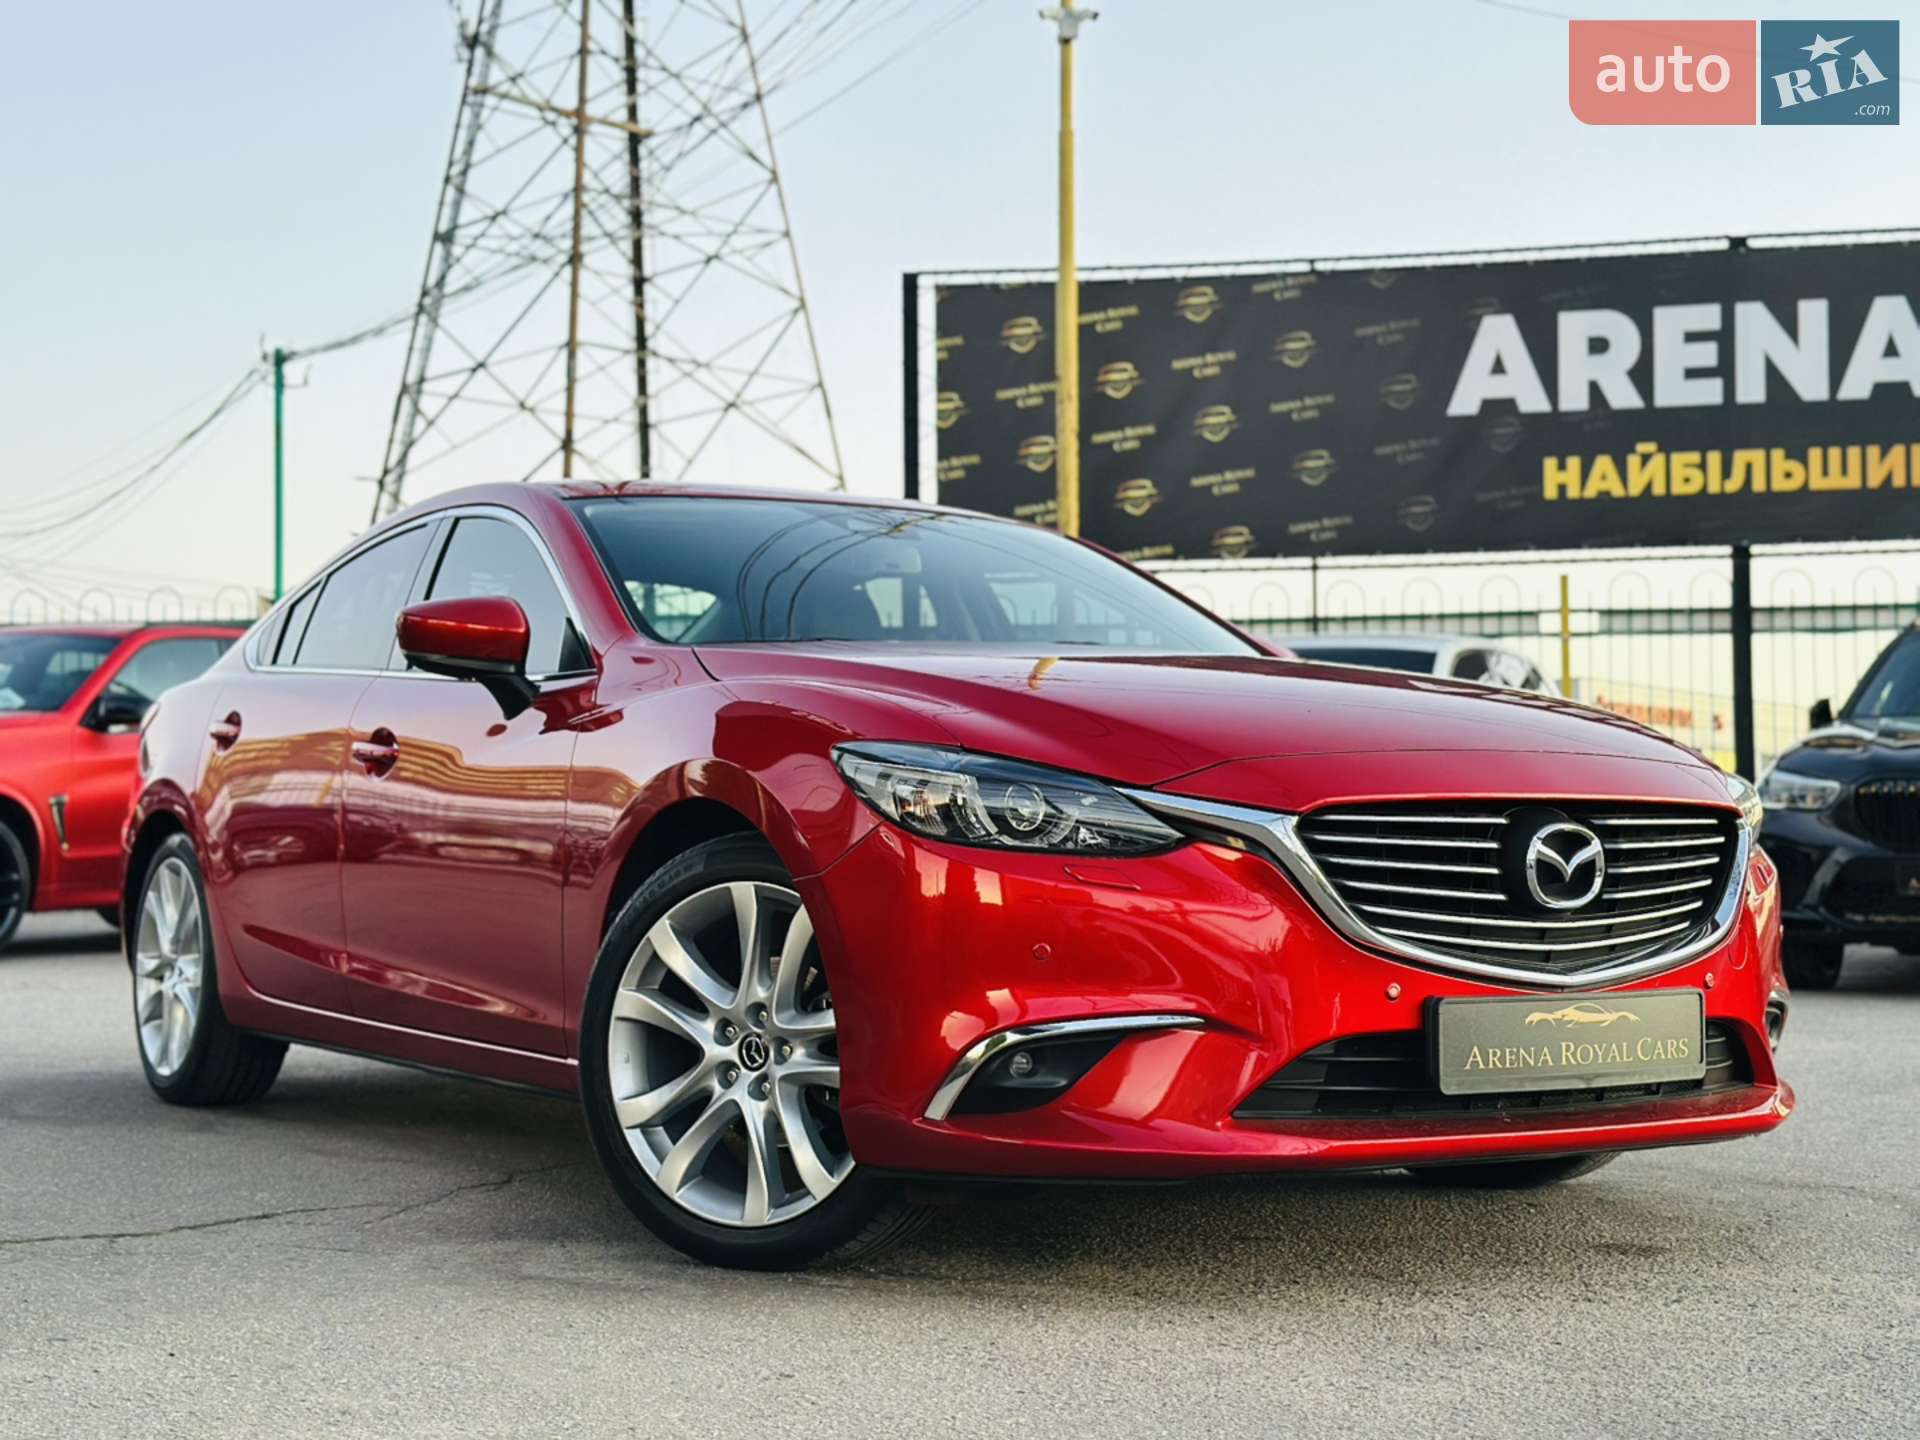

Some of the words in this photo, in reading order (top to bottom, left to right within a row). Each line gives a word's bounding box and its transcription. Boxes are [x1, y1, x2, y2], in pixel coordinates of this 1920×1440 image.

[1446, 295, 1920, 417] ARENA
[1543, 441, 1920, 500] НАЙБІЛЬШИ
[1463, 1044, 1555, 1071] ARENA
[1560, 1040, 1634, 1066] ROYAL
[1636, 1036, 1690, 1061] CARS
